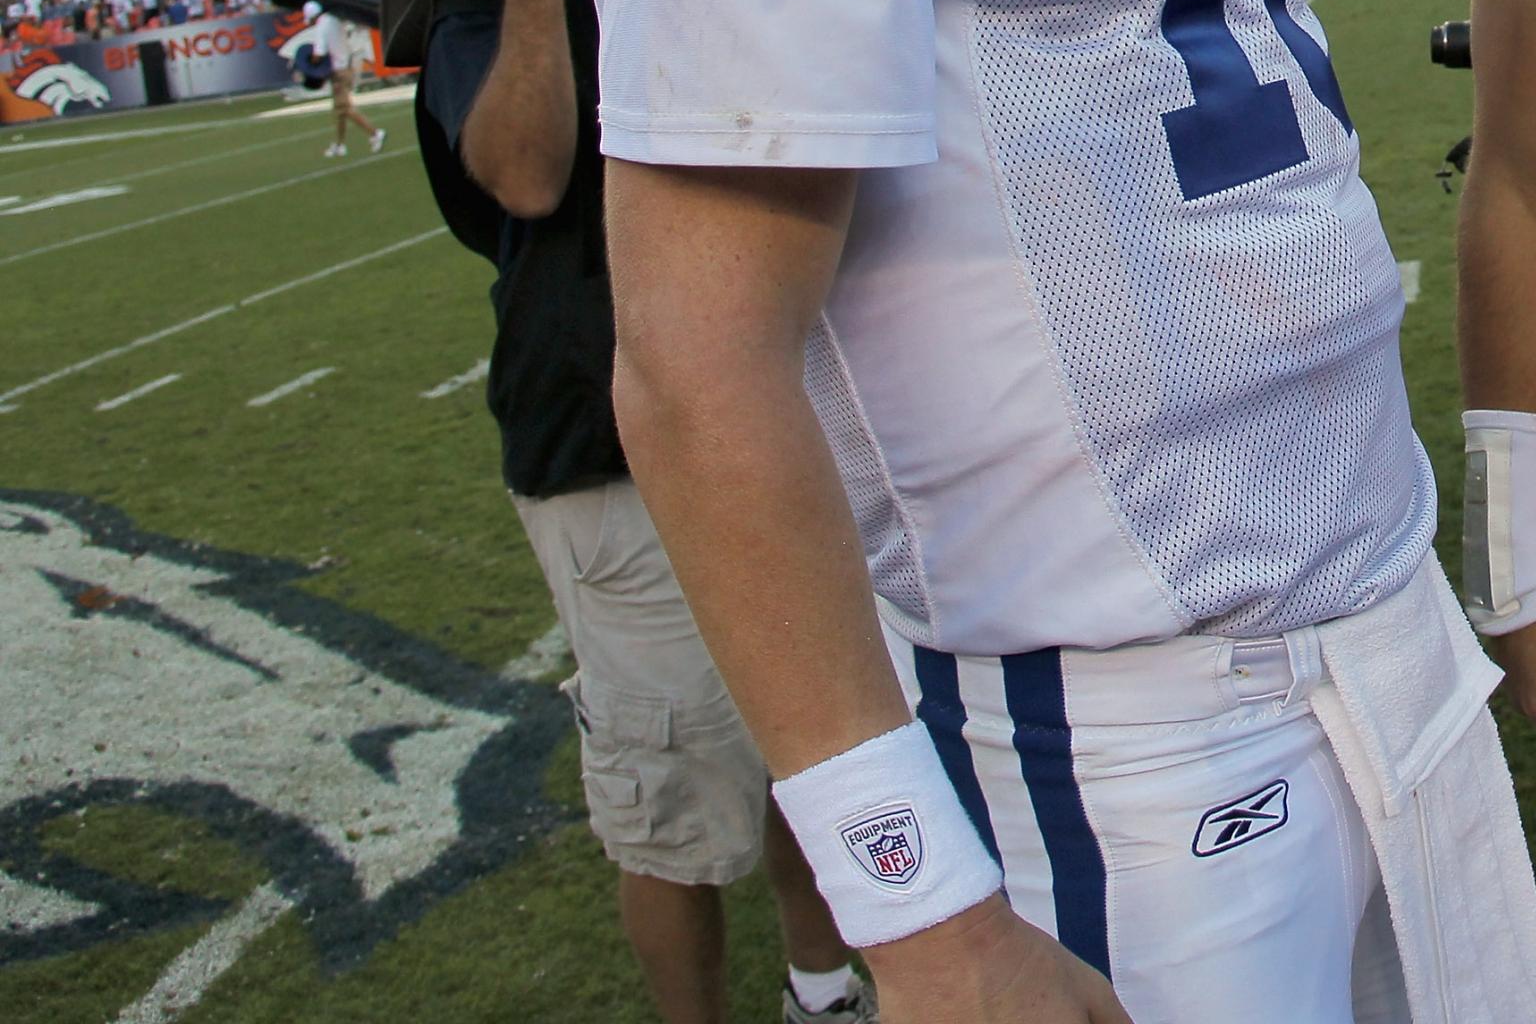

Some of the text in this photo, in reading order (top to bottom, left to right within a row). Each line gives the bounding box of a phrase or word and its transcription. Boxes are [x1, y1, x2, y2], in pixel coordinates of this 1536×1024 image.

[104, 25, 257, 71] BRNCOS
[847, 815, 914, 846] EQUIPMENT
[876, 849, 912, 873] NFL
